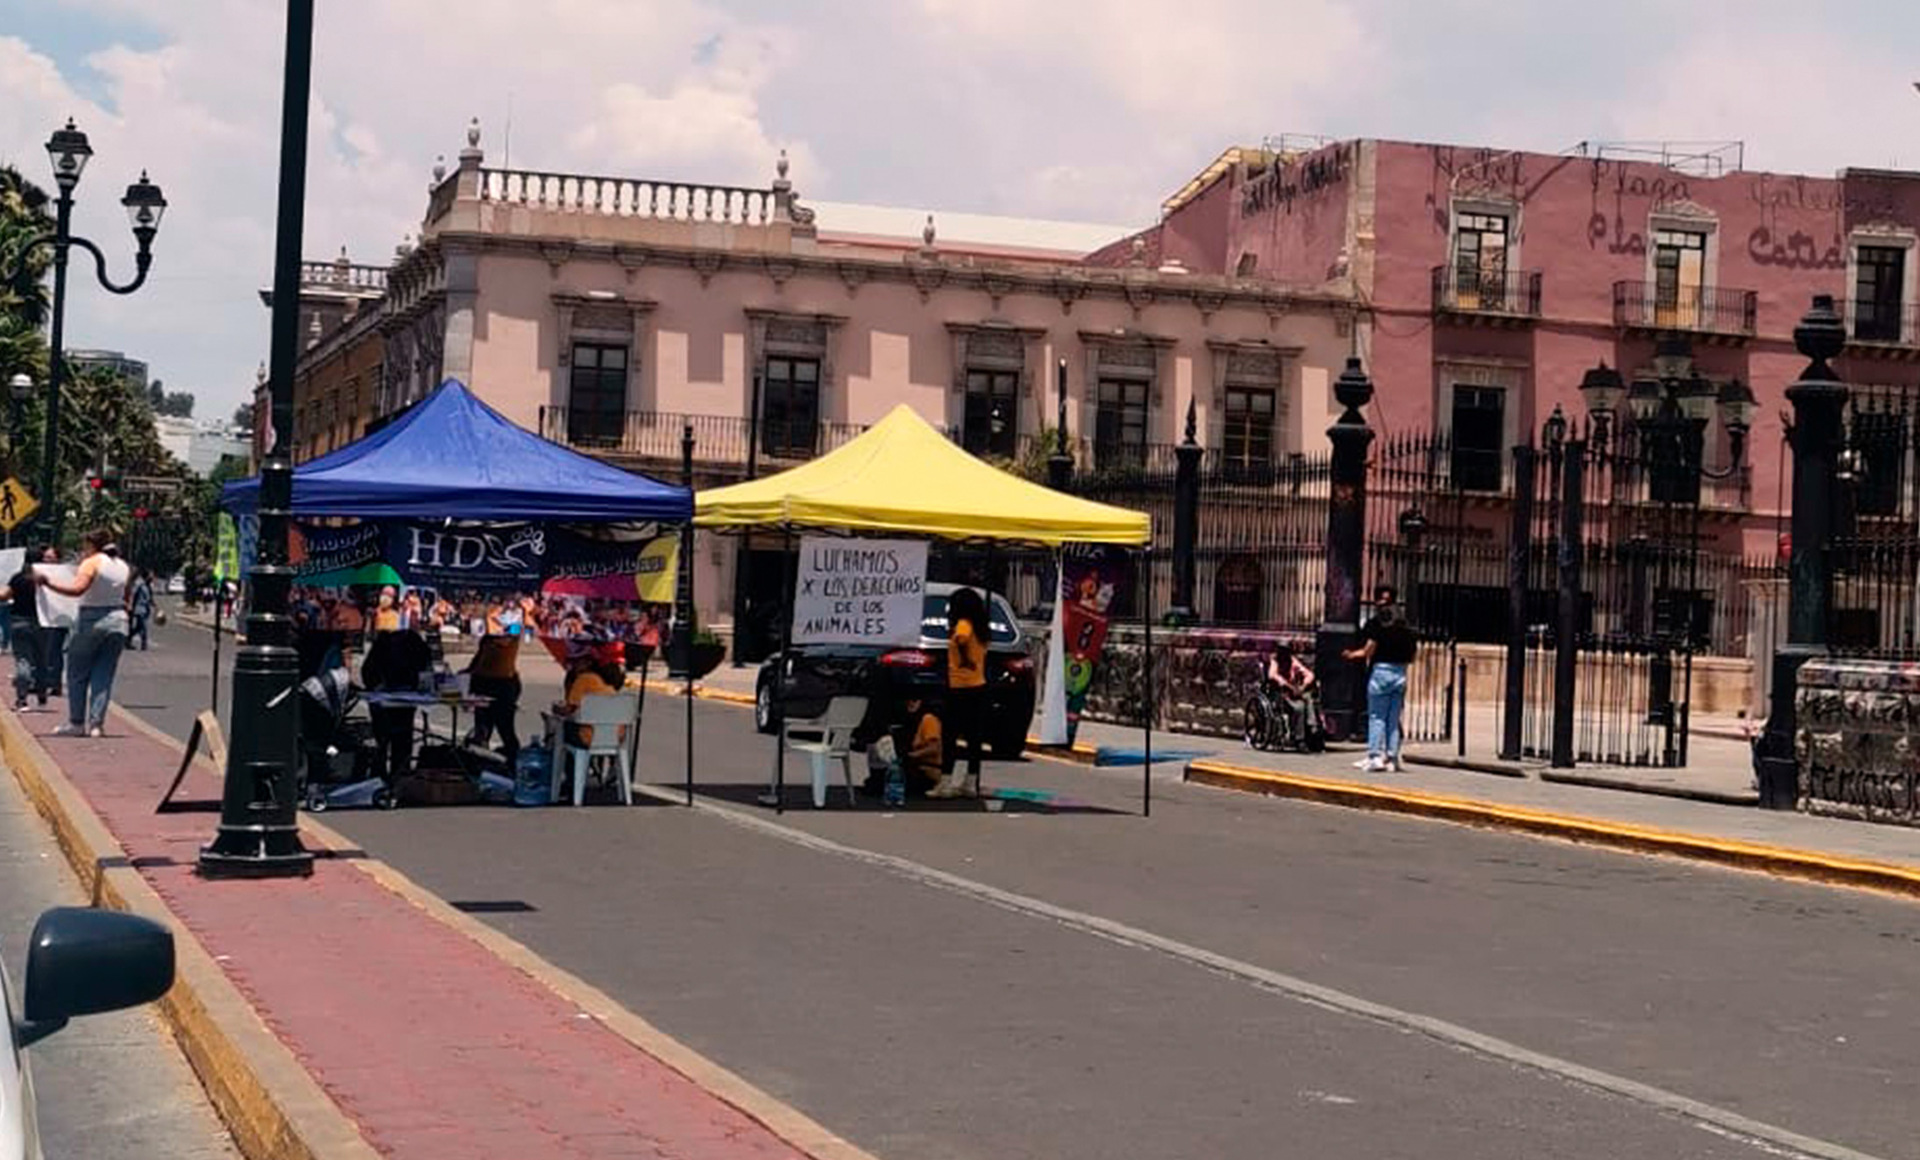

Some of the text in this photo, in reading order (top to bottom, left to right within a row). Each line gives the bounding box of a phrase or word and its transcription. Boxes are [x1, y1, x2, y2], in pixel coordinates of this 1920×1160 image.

[813, 548, 899, 575] LUCHAMOS
[823, 577, 849, 599] LOS
[851, 576, 921, 597] DERECHOS
[834, 601, 884, 614] DE LOS
[802, 618, 886, 635] ANIMALES
